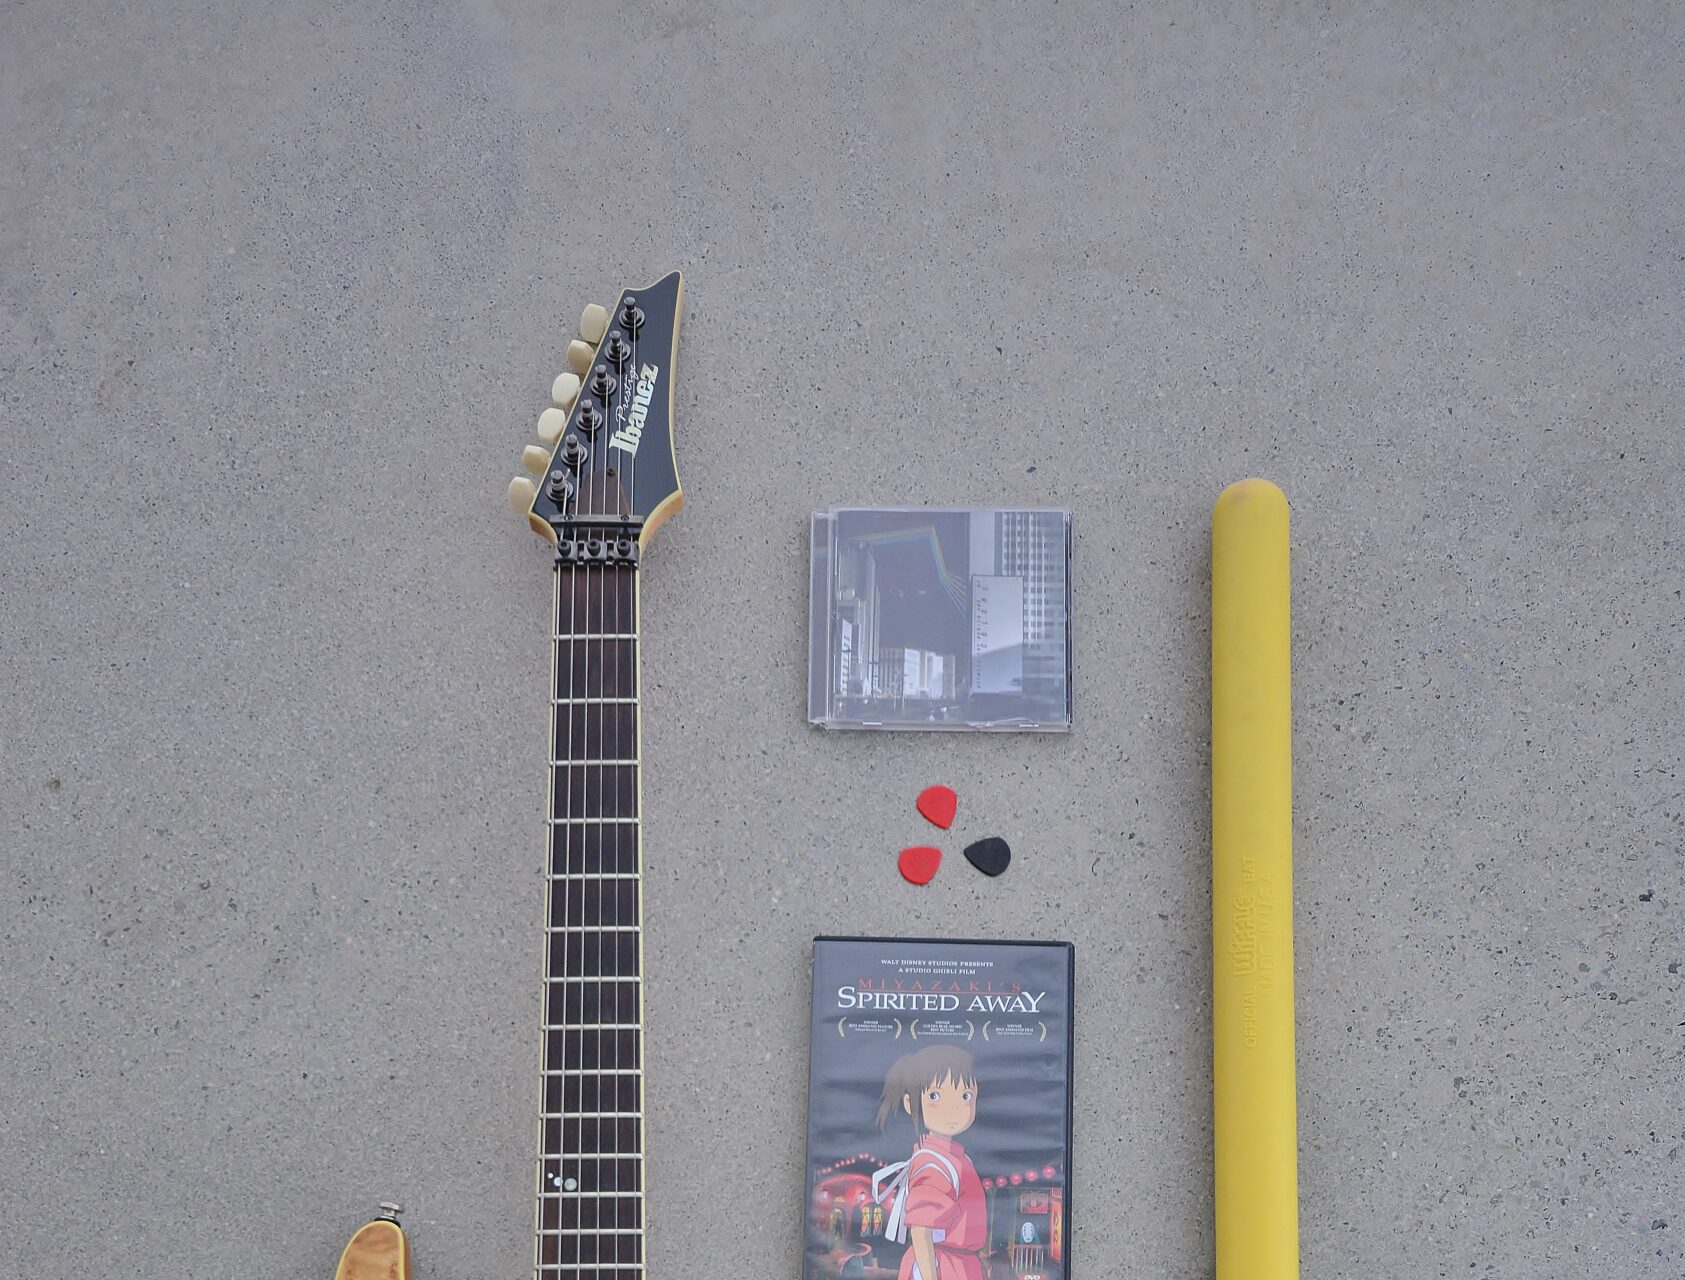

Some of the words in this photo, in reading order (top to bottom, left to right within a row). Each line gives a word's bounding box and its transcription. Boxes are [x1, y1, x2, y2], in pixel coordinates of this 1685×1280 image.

[609, 363, 659, 458] Ibanez
[615, 362, 639, 422] Prestige
[1242, 855, 1256, 884] BAT
[838, 986, 960, 1012] SPIRITED
[967, 991, 1046, 1013] AWAY
[858, 978, 1021, 993] MIYAZAKI'S
[1243, 985, 1257, 1048] OFFICIAL
